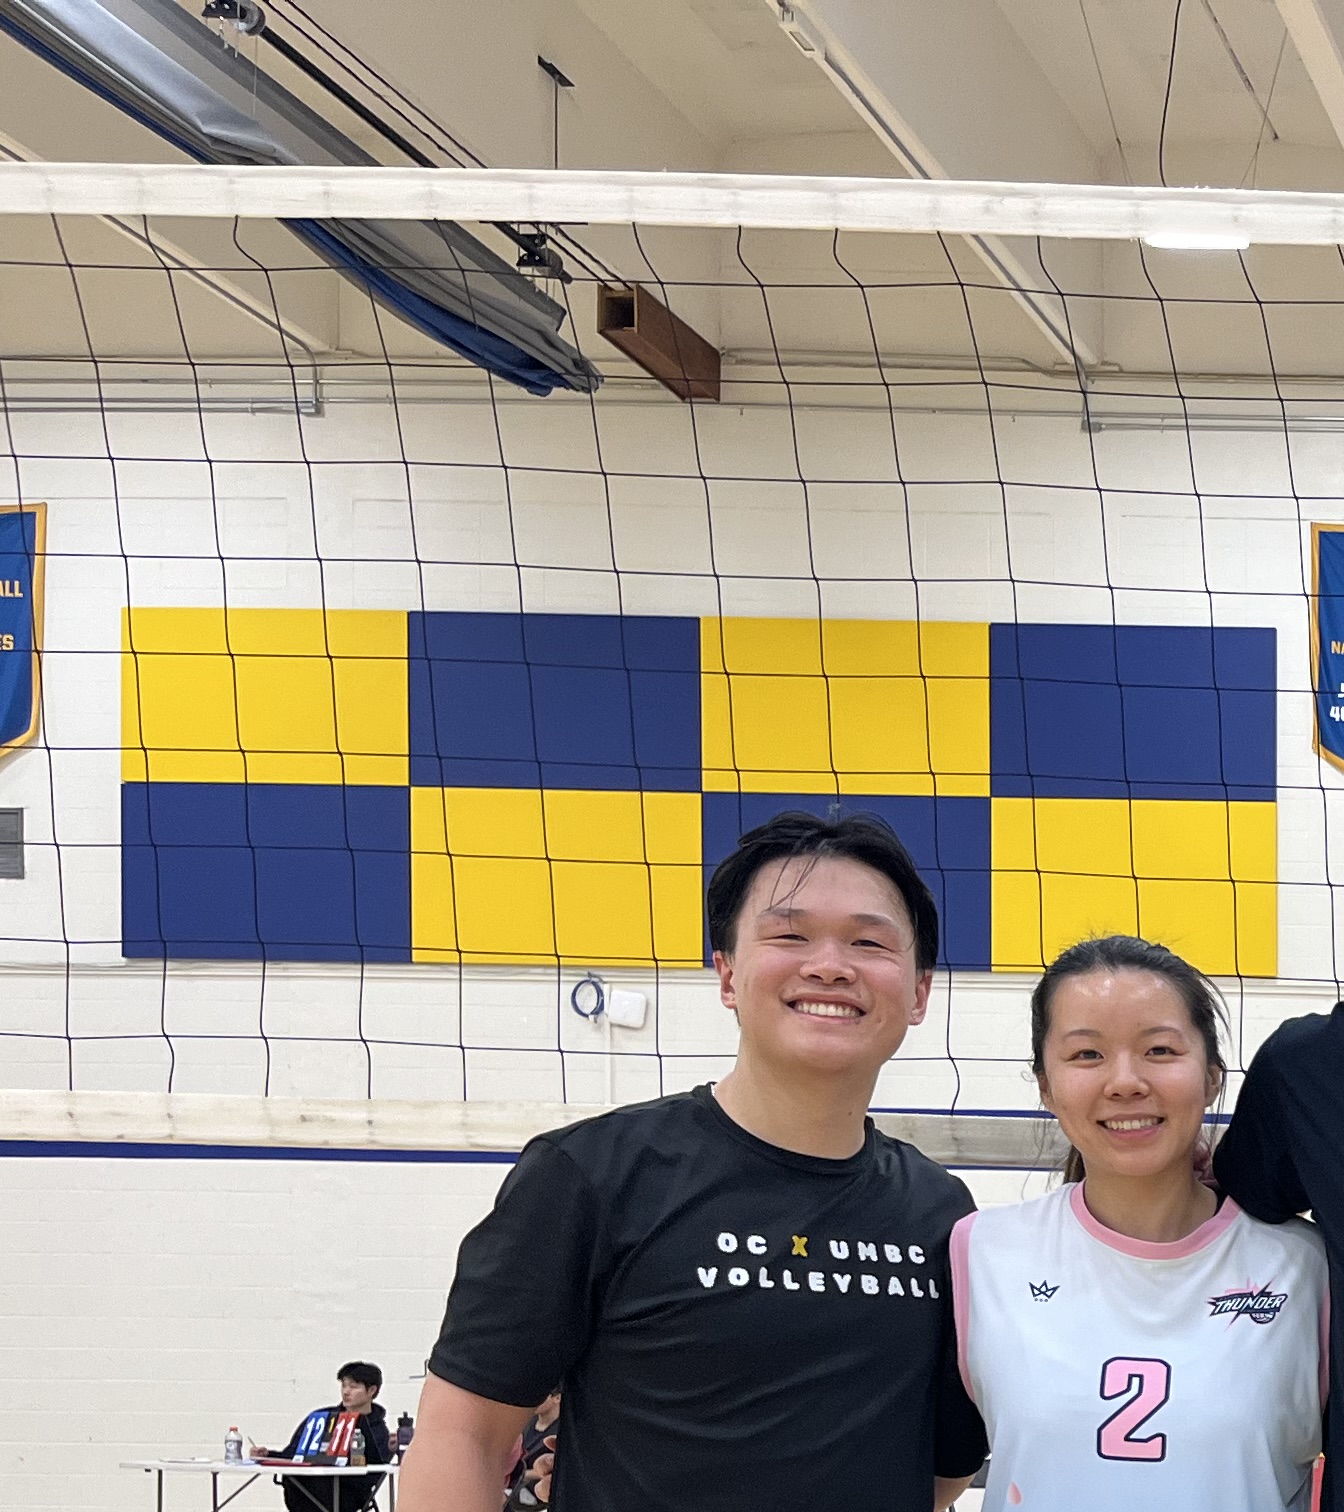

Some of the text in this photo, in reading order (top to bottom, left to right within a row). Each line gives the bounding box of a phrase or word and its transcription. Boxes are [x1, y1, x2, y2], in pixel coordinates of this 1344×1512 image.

[0, 634, 14, 651] S
[717, 1232, 926, 1265] OC X UMBC
[697, 1266, 940, 1300] VOLLEYBALL
[1215, 1296, 1285, 1314] THUNDER
[1096, 1356, 1172, 1462] 2
[301, 1416, 355, 1452] 12 1 11
